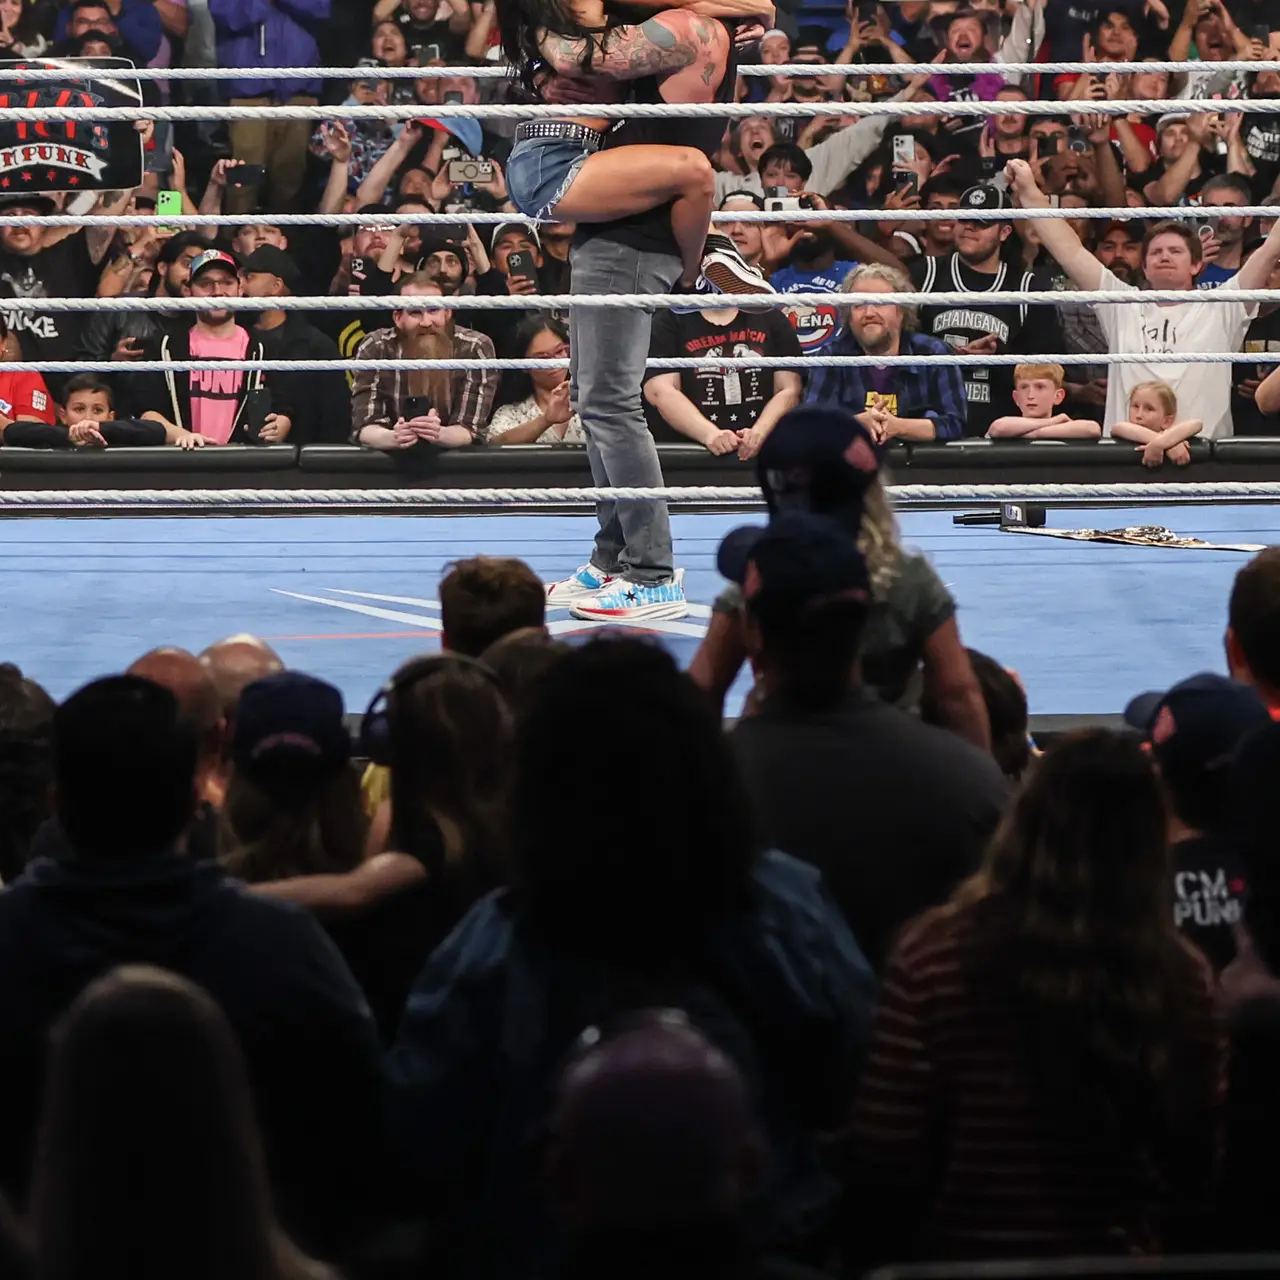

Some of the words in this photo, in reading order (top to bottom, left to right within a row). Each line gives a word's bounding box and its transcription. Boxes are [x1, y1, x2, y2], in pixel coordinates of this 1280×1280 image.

[22, 145, 91, 170] PUNK
[933, 309, 1009, 345] CHAINGANG
[1175, 869, 1228, 900] CM
